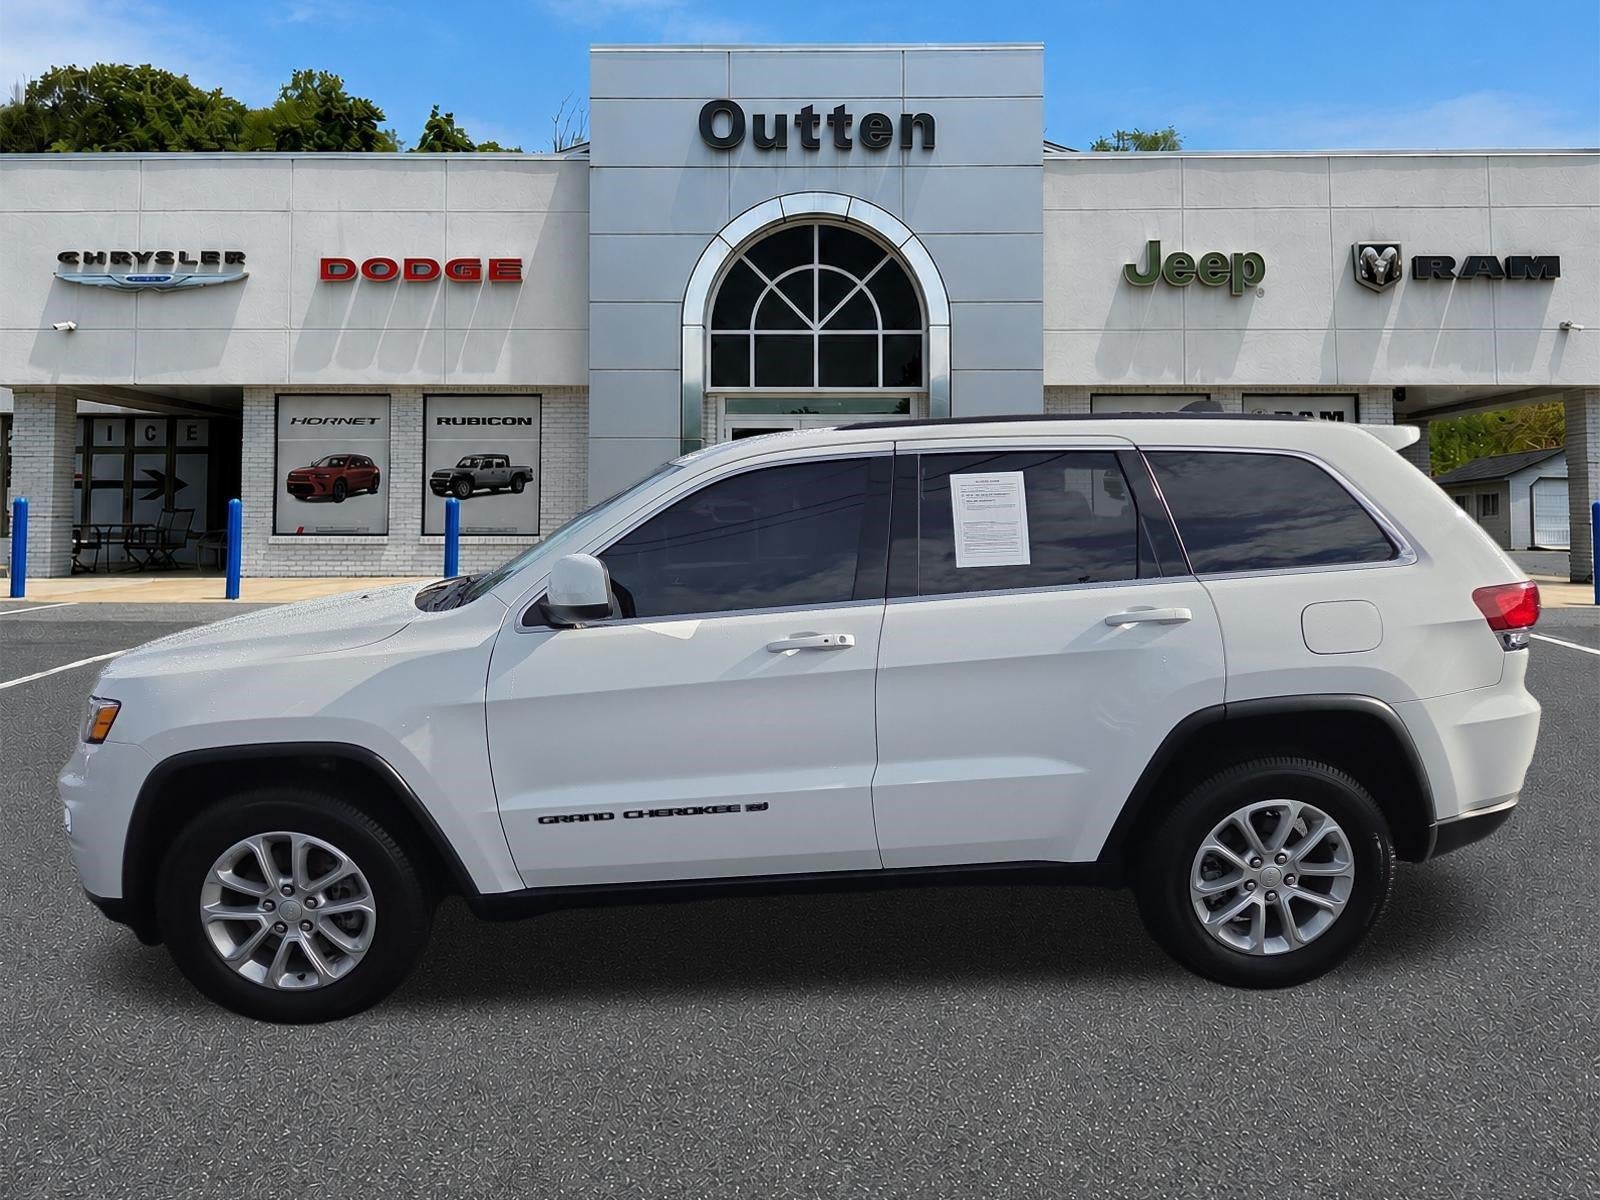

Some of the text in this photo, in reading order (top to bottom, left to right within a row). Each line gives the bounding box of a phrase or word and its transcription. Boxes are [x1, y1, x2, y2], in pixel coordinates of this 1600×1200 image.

[699, 99, 936, 151] Outten
[57, 250, 247, 266] CHRYSLER
[1123, 240, 1266, 297] Jeep
[1412, 255, 1561, 280] RAM
[320, 257, 523, 283] DODGE
[290, 416, 380, 426] HORNET
[436, 416, 533, 426] RUBICON
[537, 812, 615, 825] GRAND
[623, 803, 741, 819] CHEROKEE
